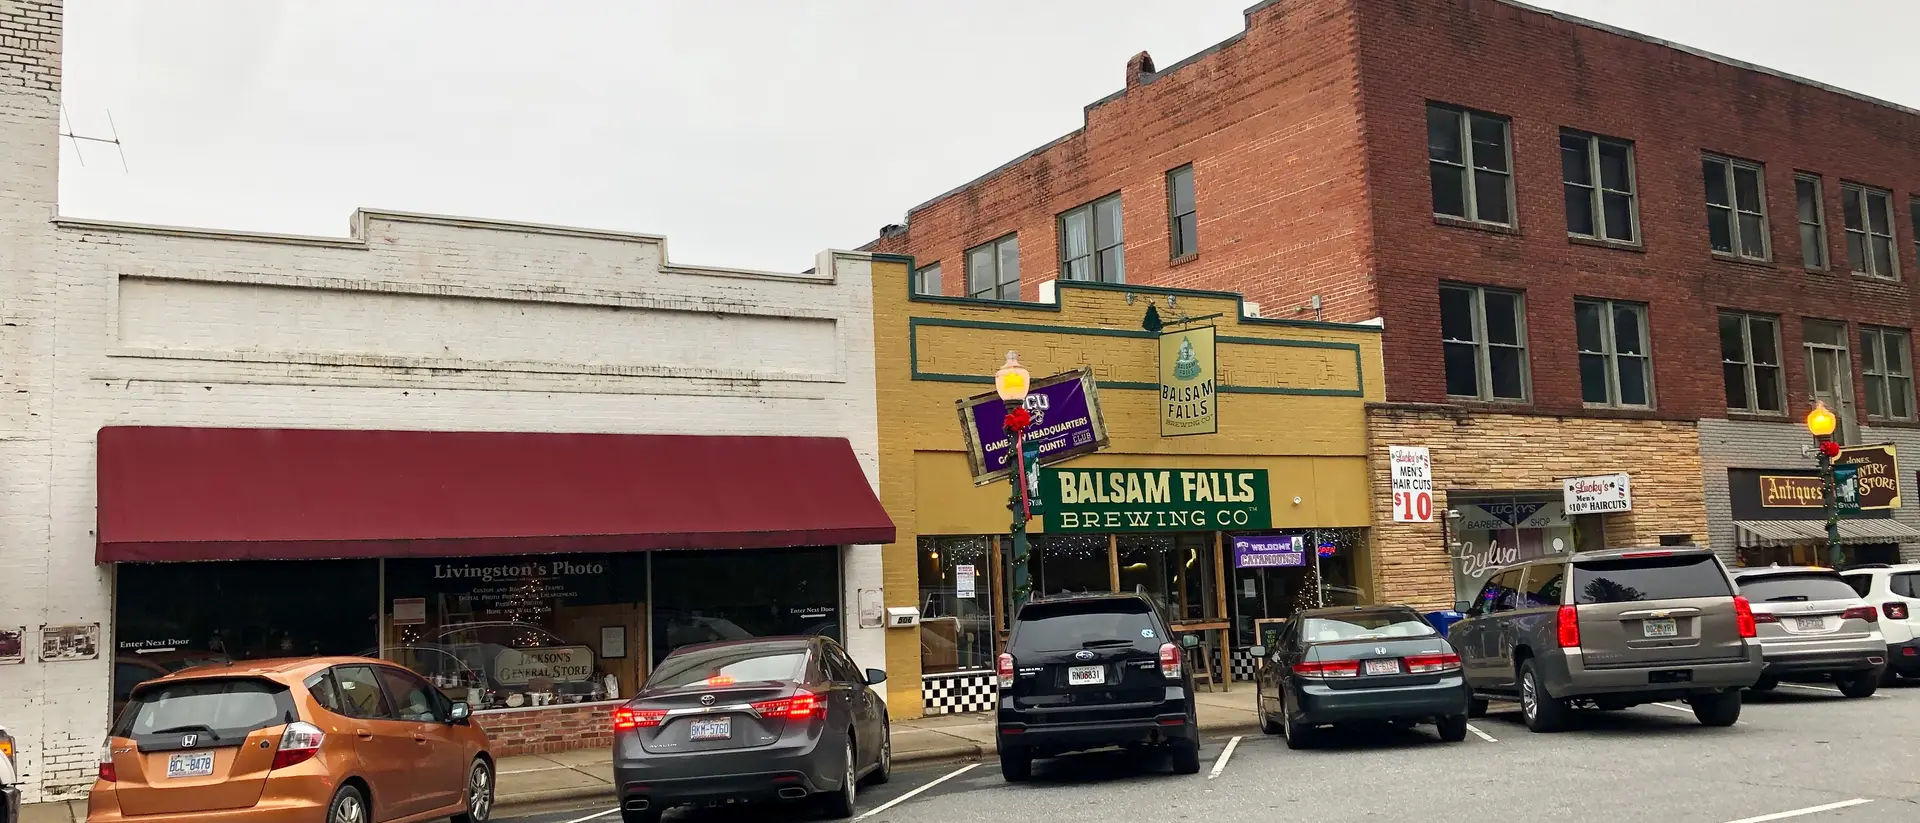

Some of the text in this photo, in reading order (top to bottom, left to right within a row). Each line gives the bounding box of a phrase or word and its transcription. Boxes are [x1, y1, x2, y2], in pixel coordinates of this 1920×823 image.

[1162, 379, 1213, 402] BALSAM
[1168, 400, 1207, 419] FALLS
[1028, 417, 1088, 441] HEADQUARTERS
[1165, 419, 1200, 428] BREWING
[1073, 432, 1092, 444] CLUB
[1395, 450, 1419, 466] Lucky's
[1400, 467, 1422, 477] MEN'S
[1058, 471, 1254, 504] BALSAM FALLS
[1393, 479, 1431, 490] HAIR CUTS
[1575, 480, 1609, 496] Lucky's
[1768, 477, 1823, 505] Antiques
[1858, 476, 1896, 496] STORE
[1394, 492, 1432, 520] $10
[1490, 503, 1536, 514] LUCKY'S
[1589, 500, 1627, 511] HAIRCUTS
[1060, 510, 1206, 528] BREWING
[1468, 517, 1550, 529] BARBER SHOP
[1251, 543, 1291, 551] WELCOME
[1318, 546, 1336, 555] OPEN
[1241, 553, 1302, 566] CATAMOUNTS
[1461, 540, 1517, 578] Sylva
[434, 561, 603, 583] Livingston's Photo
[897, 616, 913, 624] 506
[120, 638, 190, 648] Enter Next Door
[518, 653, 571, 665] JACKSON'S
[501, 665, 588, 680] GENERAL STORE
[169, 758, 211, 772] BCL-8478
